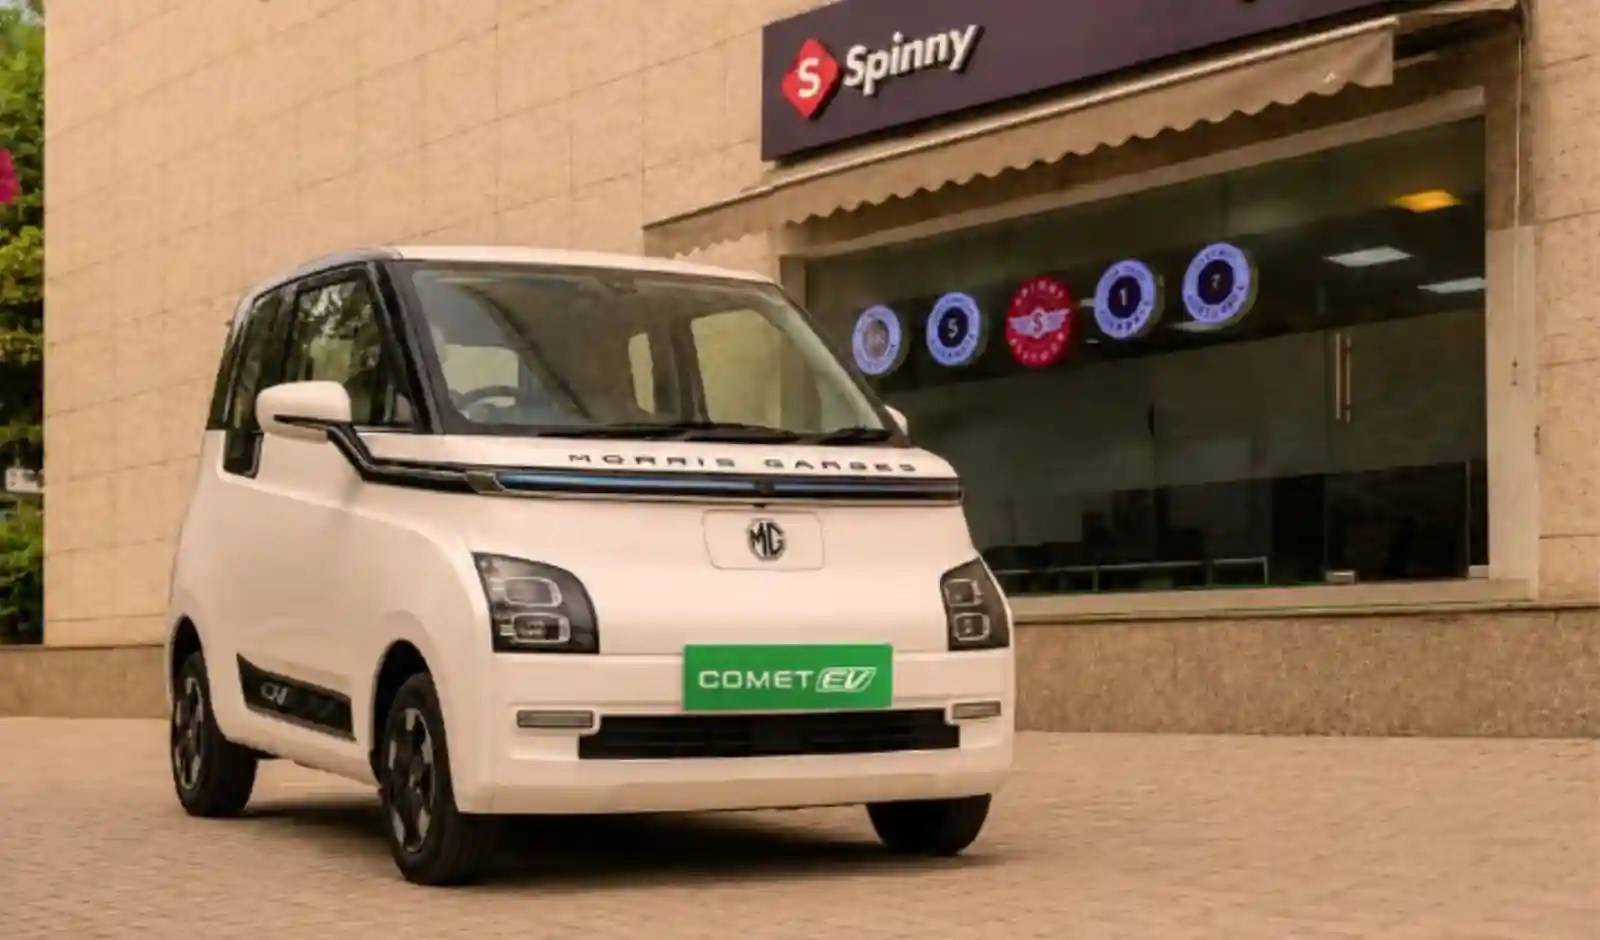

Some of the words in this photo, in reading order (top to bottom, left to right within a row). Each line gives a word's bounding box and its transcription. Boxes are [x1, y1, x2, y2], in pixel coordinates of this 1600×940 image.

[844, 24, 978, 96] Spinny
[568, 453, 736, 468] MORRIS
[749, 520, 785, 558] MG
[698, 669, 814, 689] COMET
[820, 668, 874, 691] EV
